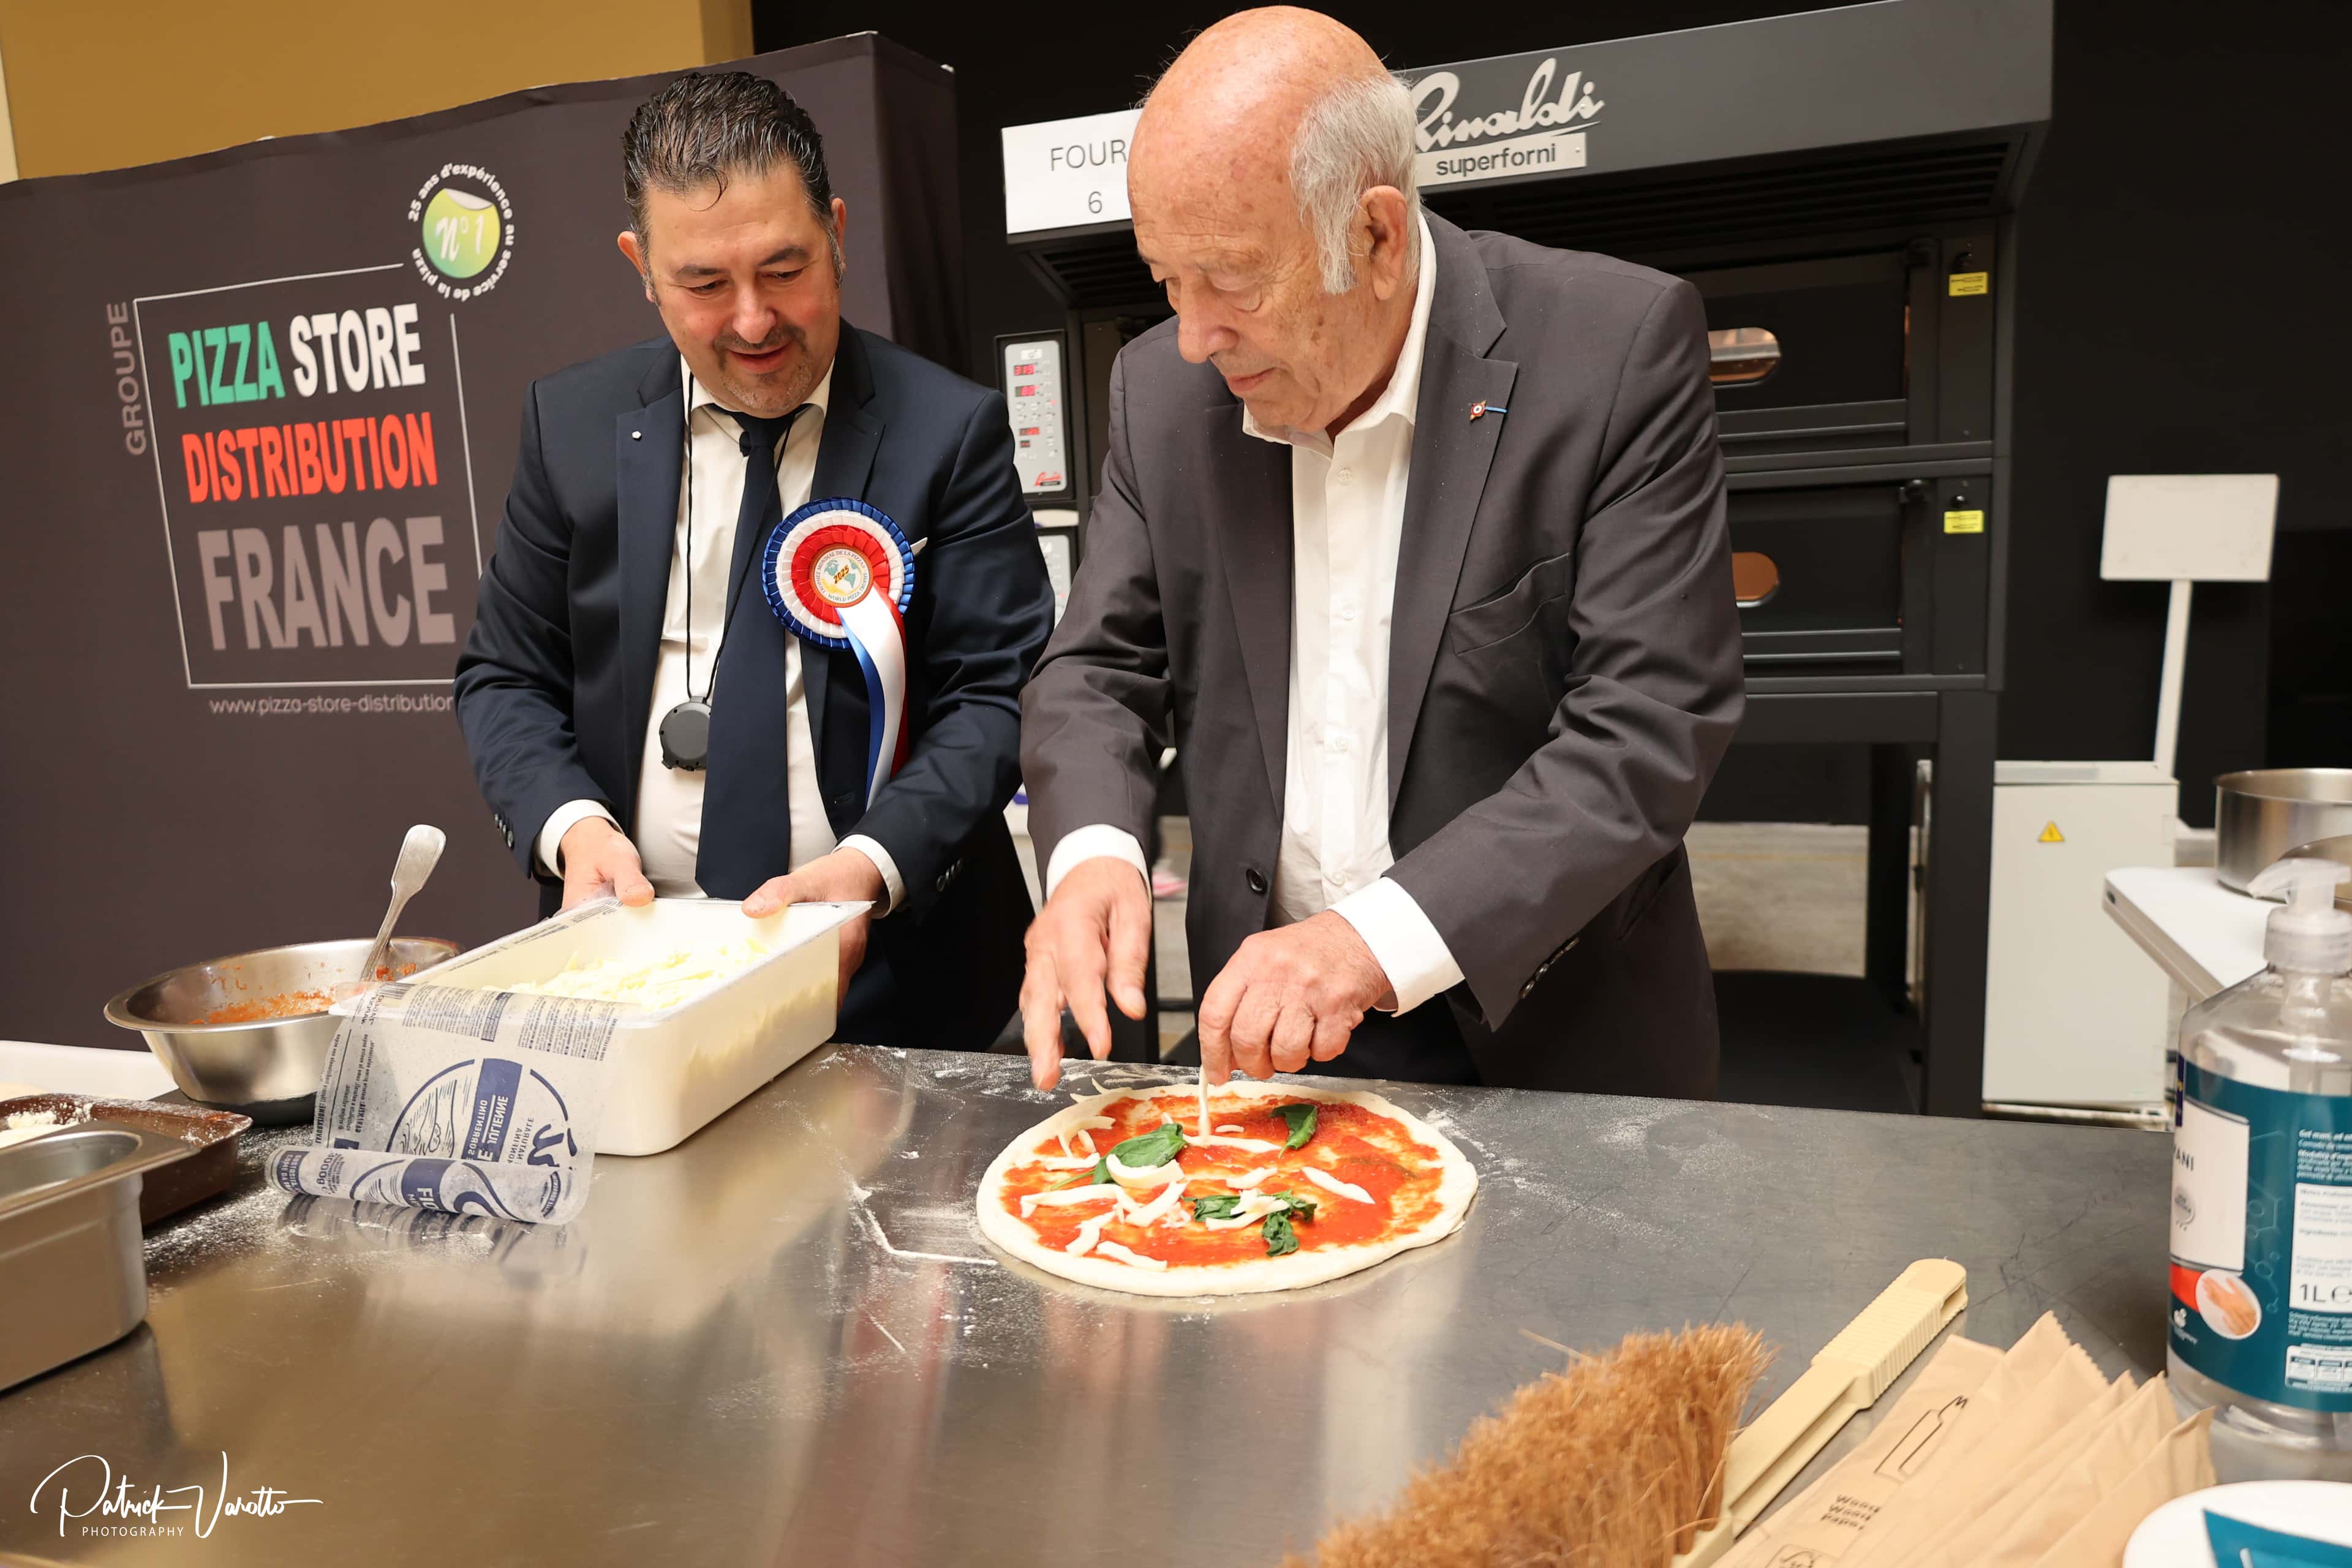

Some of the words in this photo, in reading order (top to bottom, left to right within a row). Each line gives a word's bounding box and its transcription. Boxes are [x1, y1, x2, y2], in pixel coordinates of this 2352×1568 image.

[1410, 58, 1605, 153] Rinaldi
[1050, 140, 1127, 172] FOUR
[1436, 143, 1556, 177] superforni
[418, 174, 440, 199] ans
[1088, 190, 1102, 214] 6
[408, 199, 422, 222] 25
[505, 224, 515, 246] au
[412, 248, 439, 286] pizza
[473, 249, 511, 296] service
[437, 282, 451, 299] la
[453, 288, 470, 302] de
[168, 321, 285, 409] PIZZA
[289, 303, 426, 398] STORE
[107, 301, 147, 456] GROUPE
[181, 411, 439, 503] DISTRIBUTION
[197, 515, 457, 651] FRANCE
[833, 565, 850, 584] 2025
[2299, 1283, 2326, 1303] 1L
